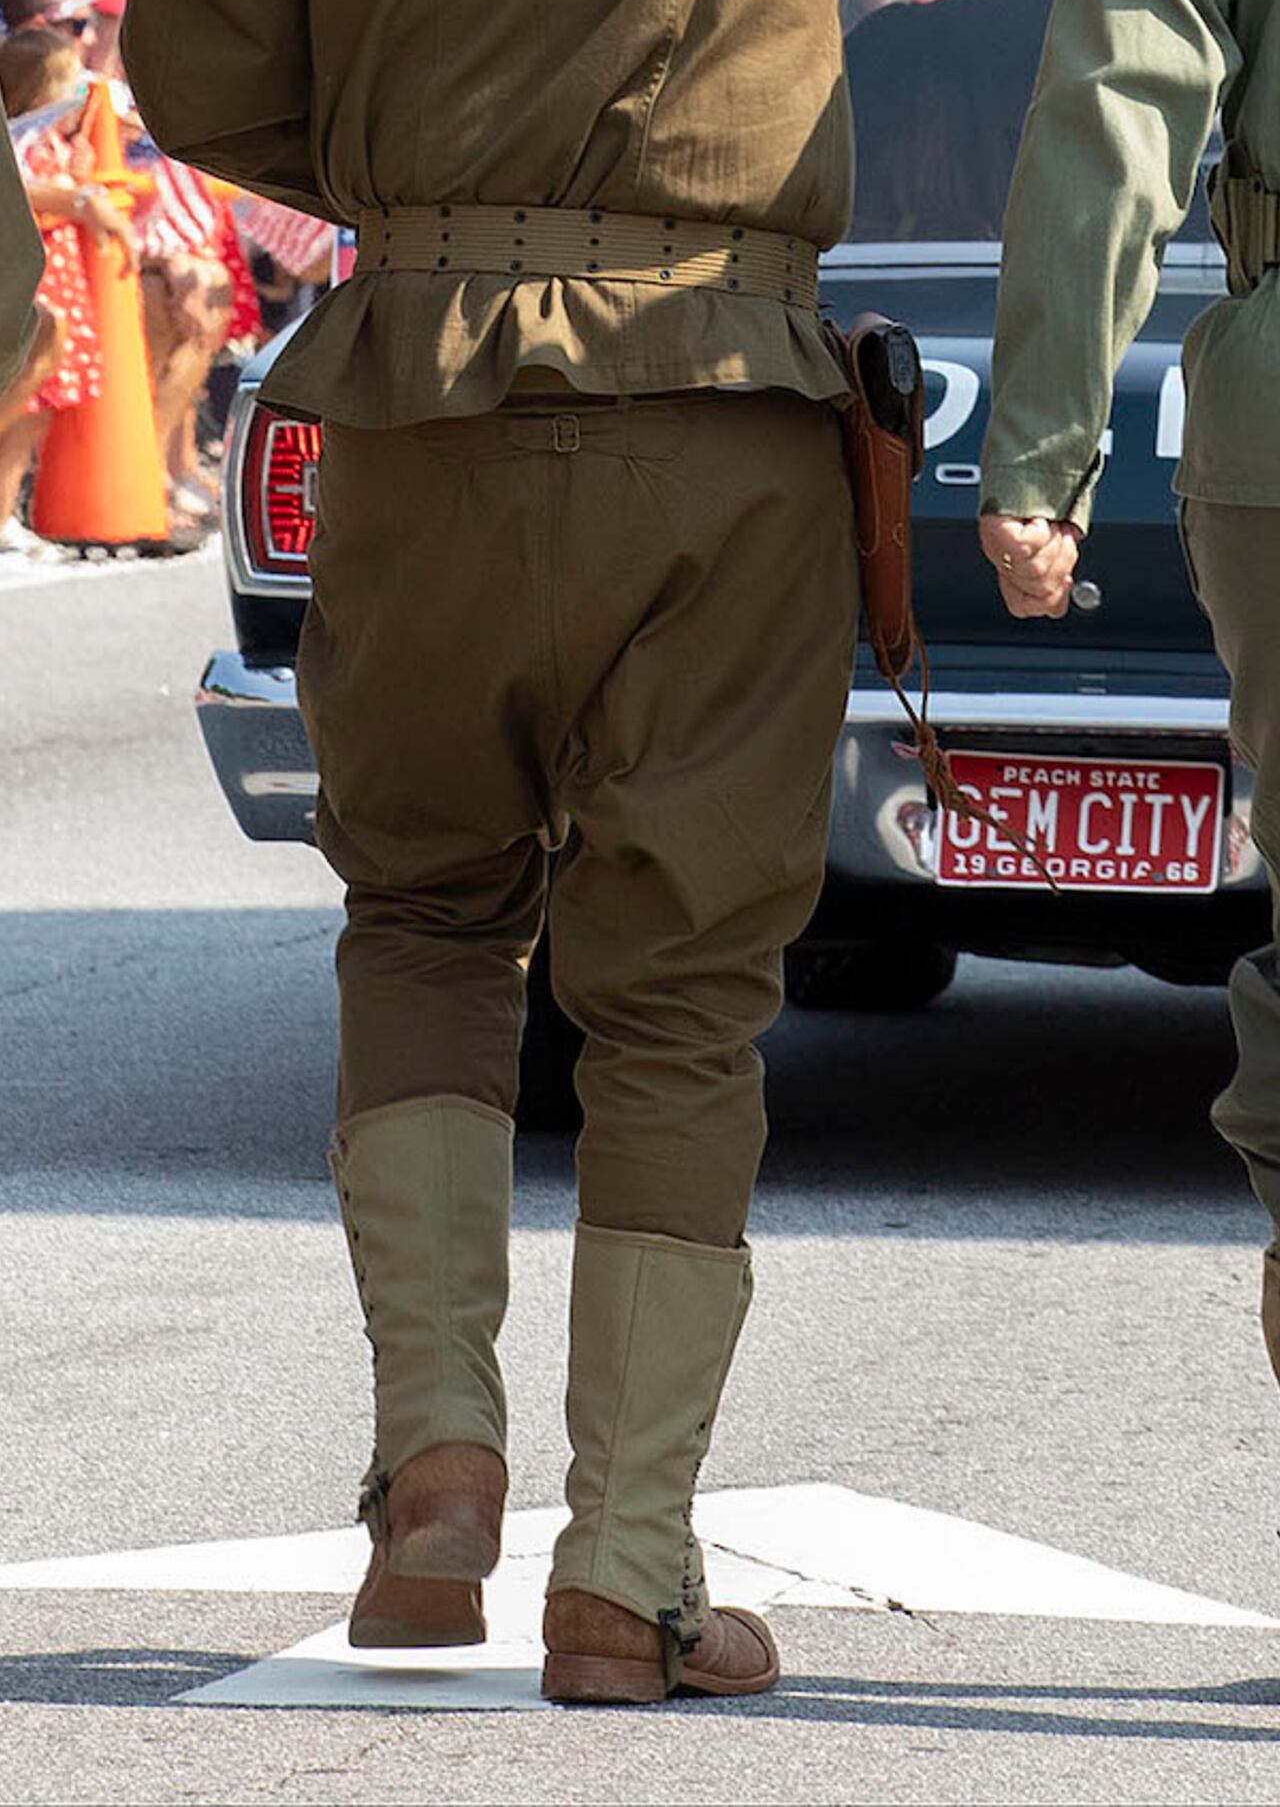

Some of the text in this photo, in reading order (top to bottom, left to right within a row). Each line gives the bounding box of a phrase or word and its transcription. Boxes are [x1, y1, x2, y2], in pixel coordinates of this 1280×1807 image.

[1002, 764, 1161, 790] PEACH STATE
[946, 783, 1212, 859] GEM CITY
[952, 852, 1200, 882] 19 GEORGIA 66
